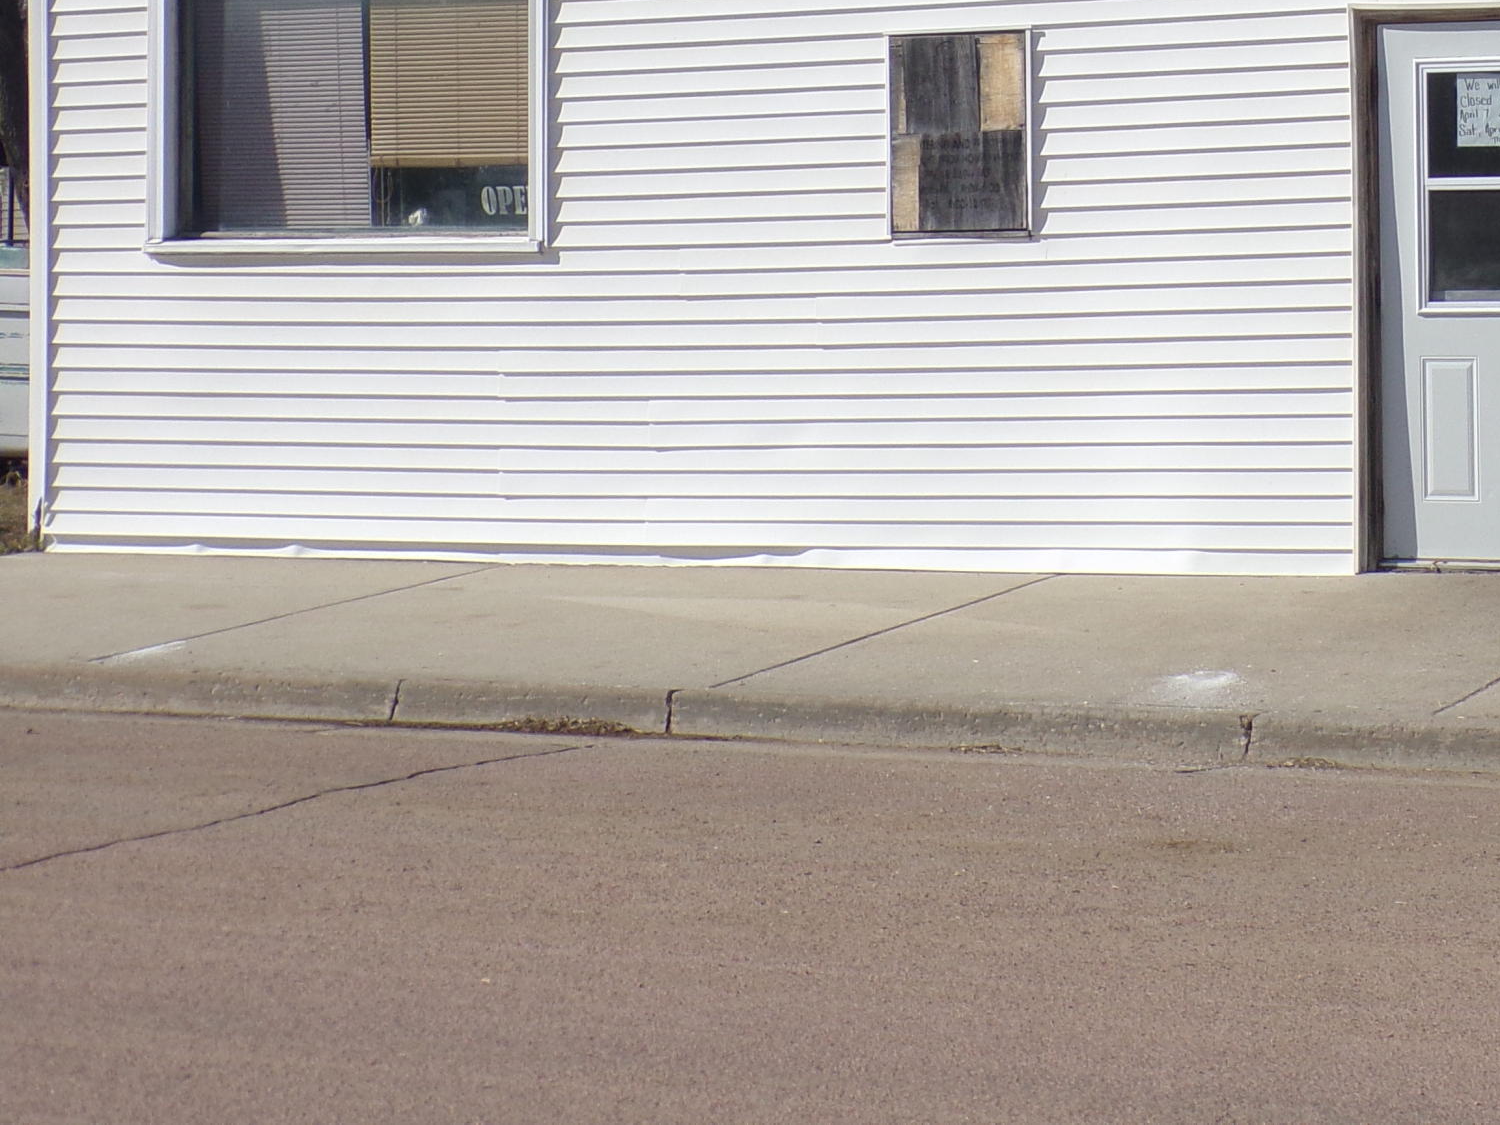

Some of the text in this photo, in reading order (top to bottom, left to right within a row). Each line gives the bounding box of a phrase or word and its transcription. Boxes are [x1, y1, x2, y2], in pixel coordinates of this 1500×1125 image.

[1464, 78, 1480, 91] We
[1460, 109, 1478, 123] April
[1483, 108, 1489, 118] 7
[480, 185, 528, 216] OPE
